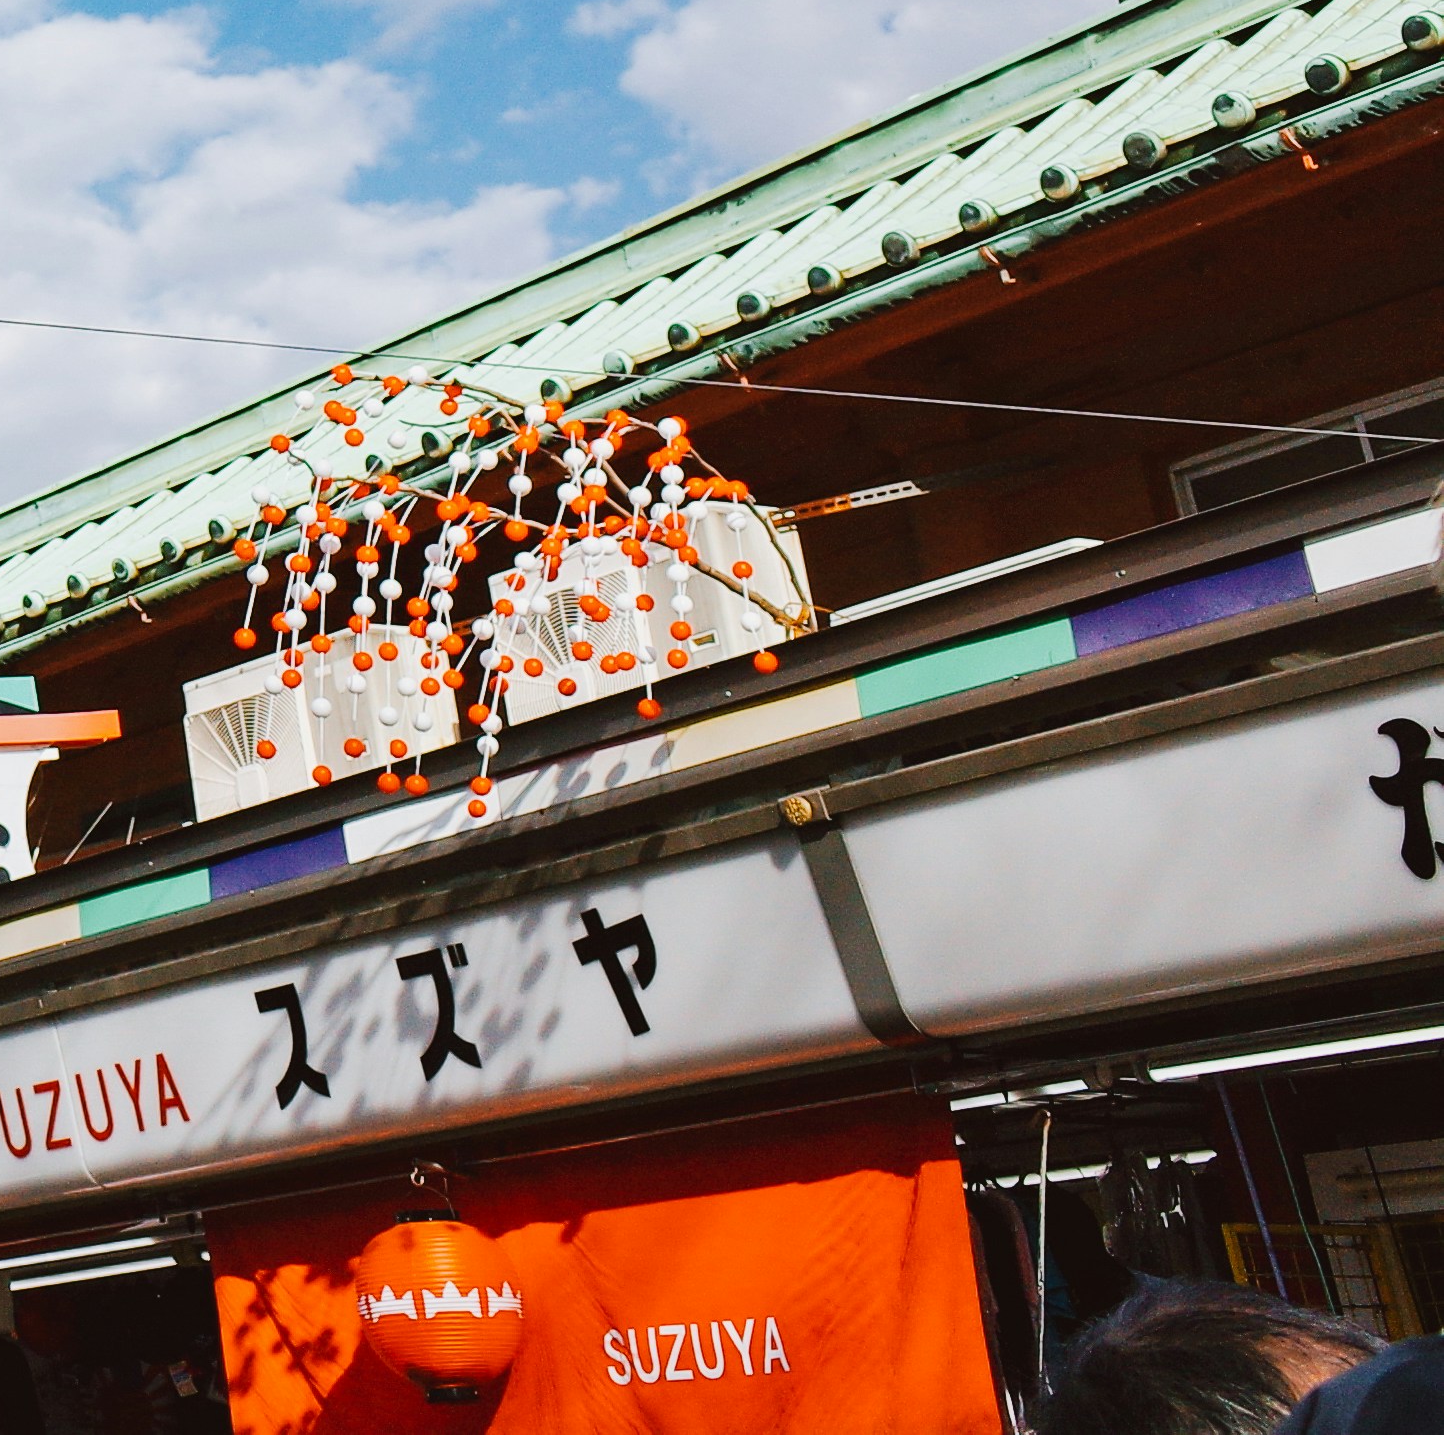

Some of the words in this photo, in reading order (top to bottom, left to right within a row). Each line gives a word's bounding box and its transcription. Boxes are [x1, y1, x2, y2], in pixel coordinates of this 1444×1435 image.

[253, 907, 658, 1111] スズヤ
[603, 1316, 791, 1386] SUZUYA
